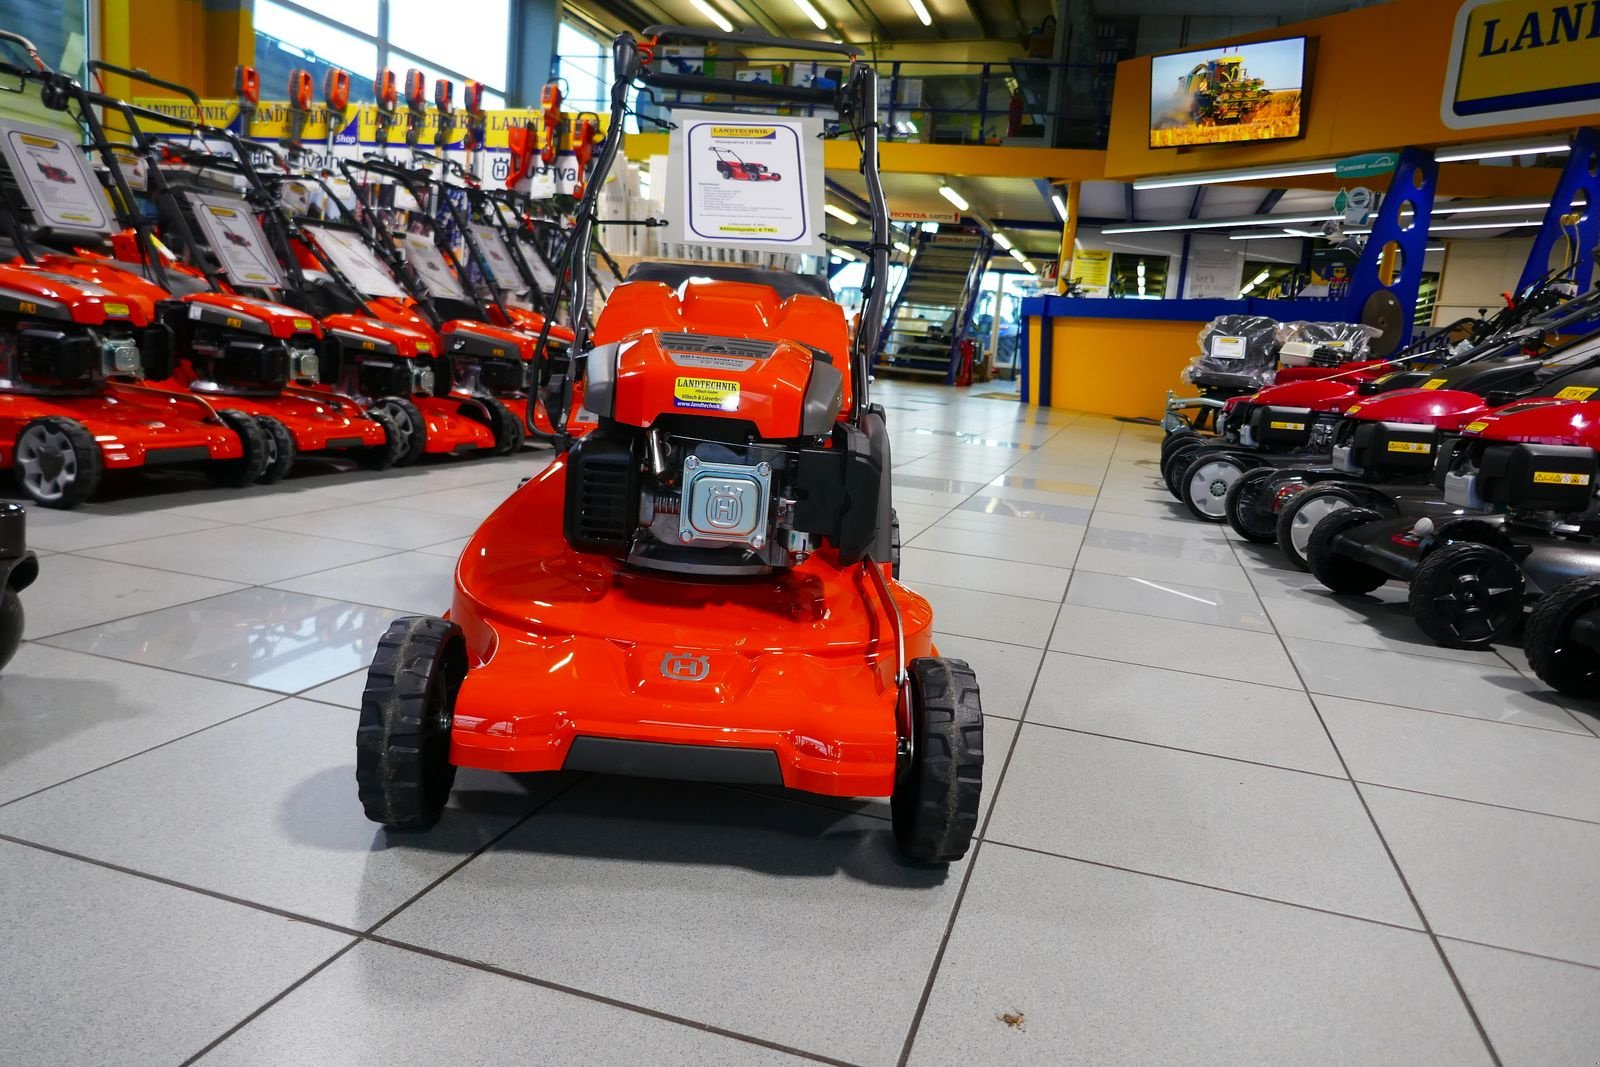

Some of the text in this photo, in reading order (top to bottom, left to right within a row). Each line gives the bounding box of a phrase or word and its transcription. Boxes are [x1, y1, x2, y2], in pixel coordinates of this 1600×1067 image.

[335, 134, 356, 145] Shop
[891, 211, 927, 219] HONDA
[677, 379, 737, 391] LANDTECHNIK
